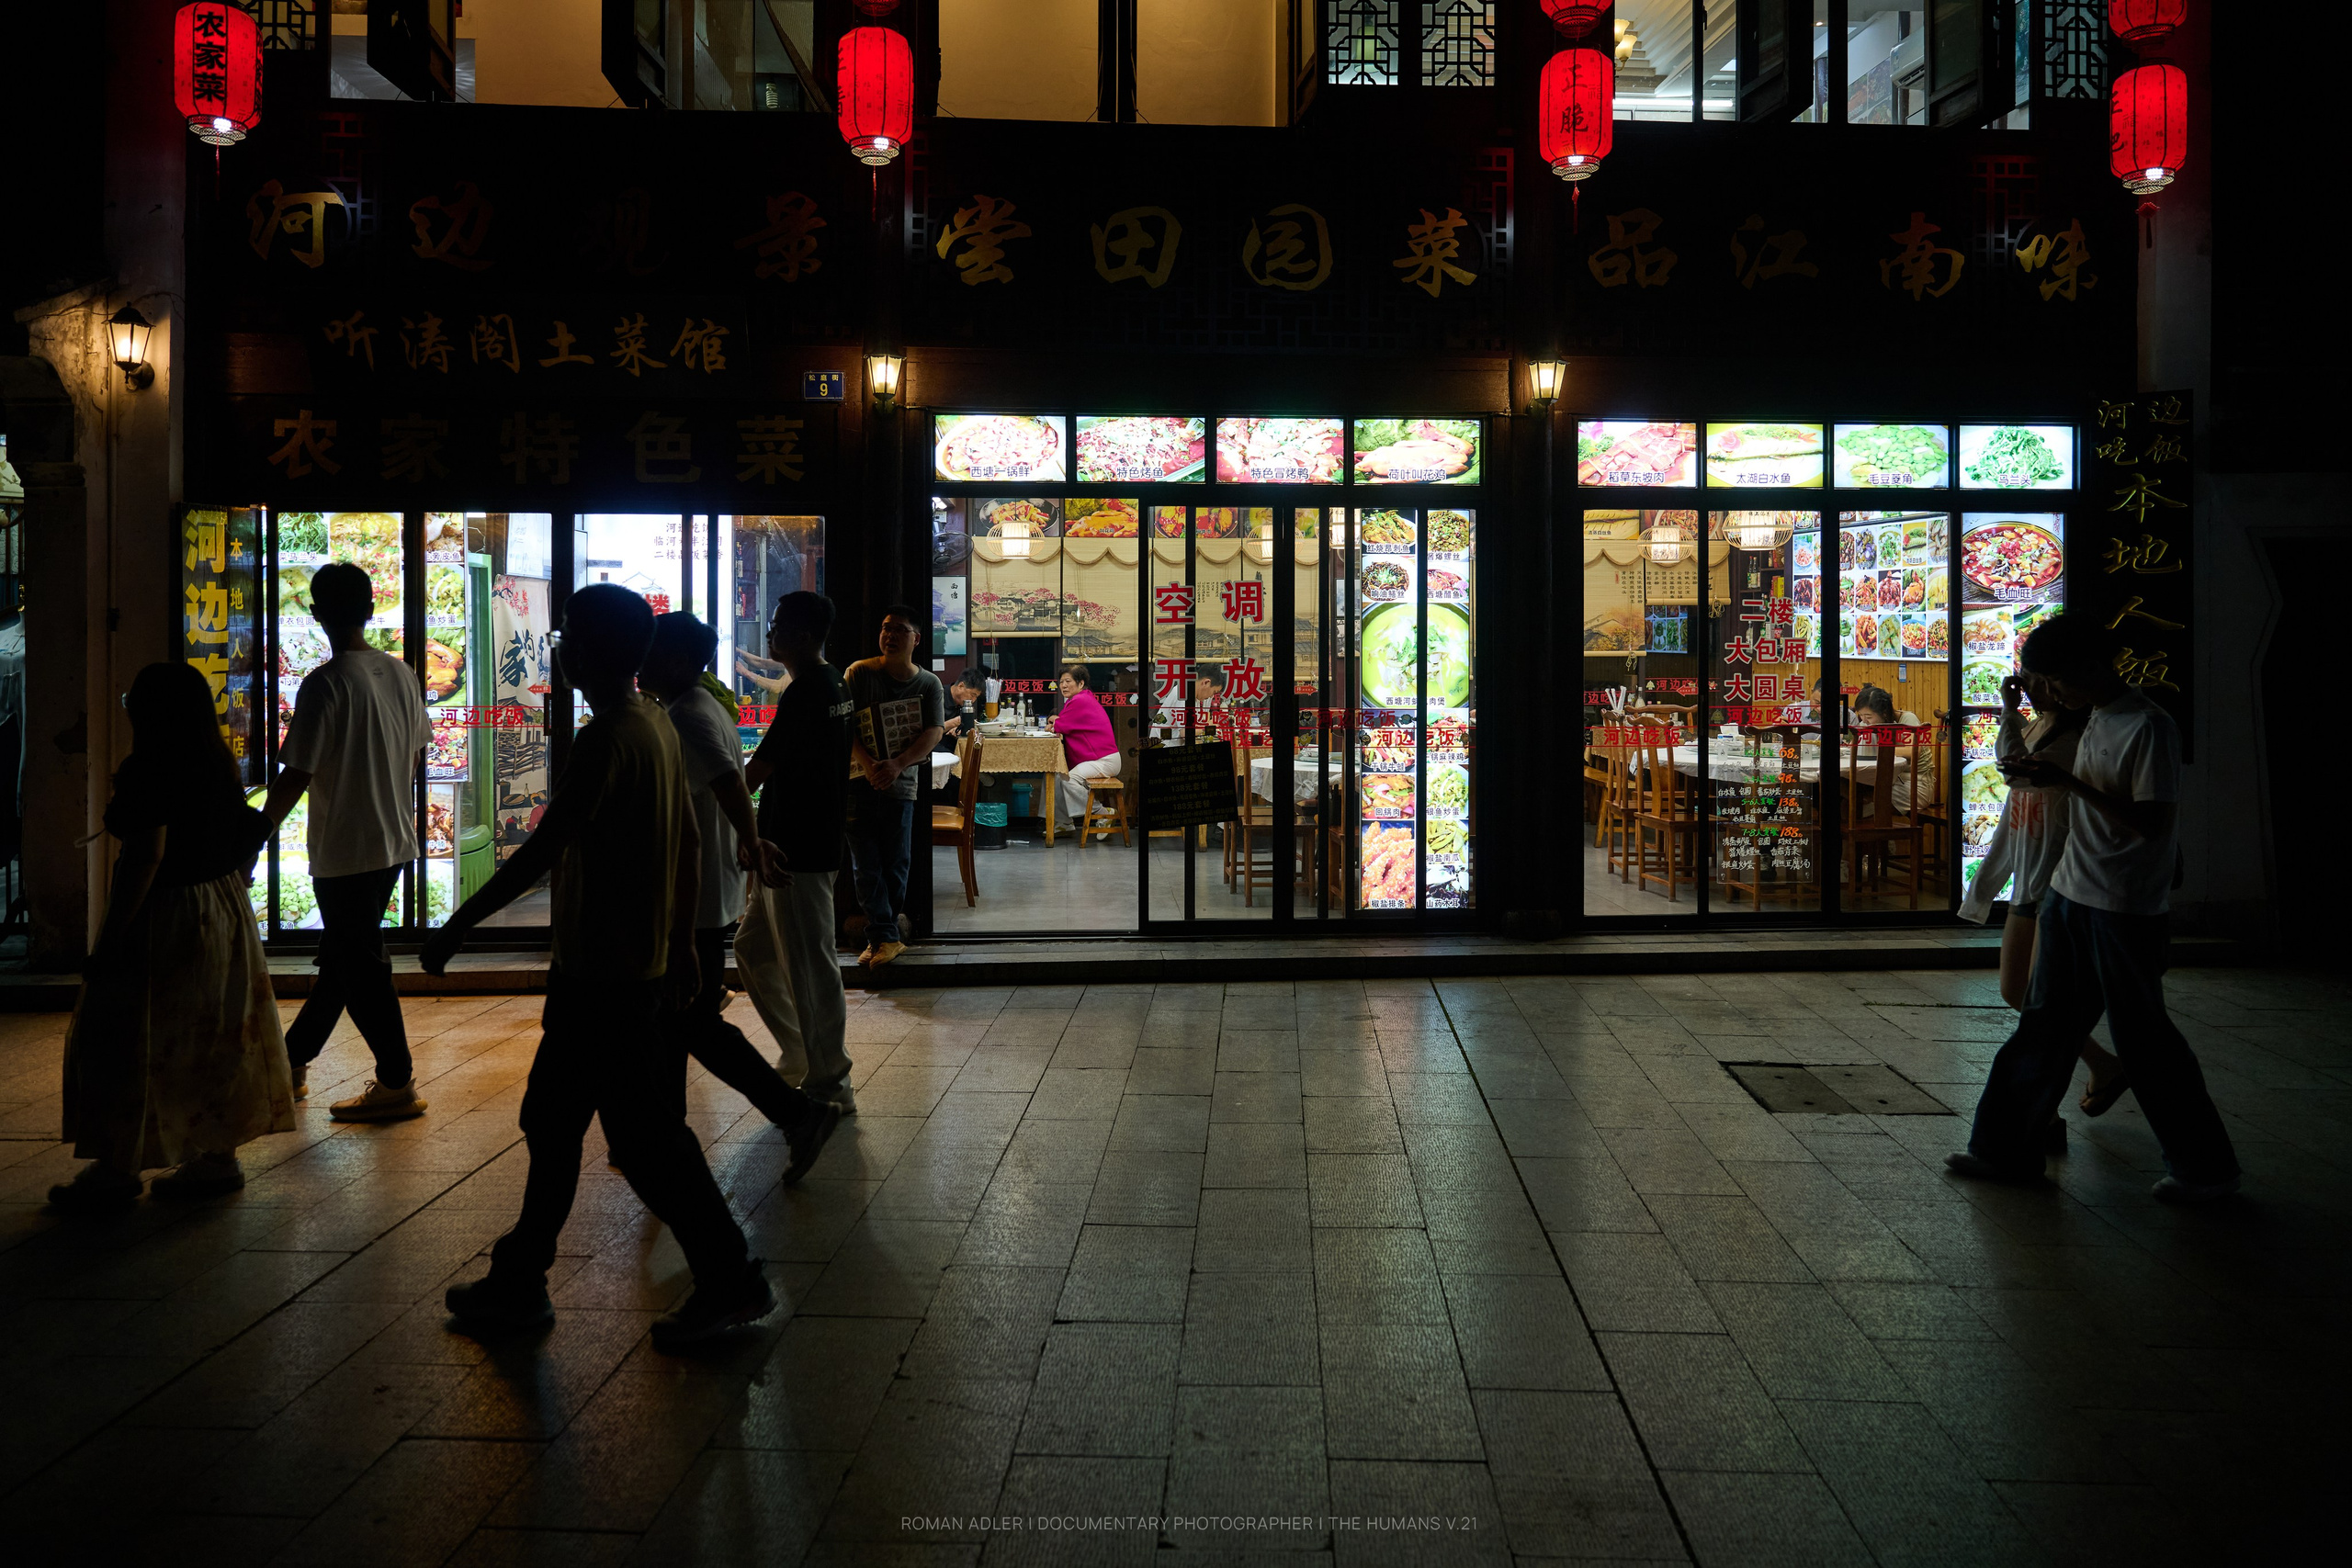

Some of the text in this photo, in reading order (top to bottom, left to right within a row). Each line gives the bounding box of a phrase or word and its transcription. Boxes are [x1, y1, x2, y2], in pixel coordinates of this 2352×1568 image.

[195, 11, 226, 102] 农家菜
[246, 179, 827, 283] 河边观景
[936, 194, 1477, 298] 尝田园菜
[1587, 207, 2098, 301] 品江南味
[322, 310, 731, 376] 听涛阁土菜馆
[820, 383, 829, 397] 9
[268, 410, 806, 485] 农家特色菜
[970, 466, 1031, 479] 西塘一锅鲜
[1116, 467, 1164, 479] 特色烤鱼
[1250, 467, 1309, 479] 特色冒烤鸭
[1388, 468, 1447, 481] 荷叶叫花鸡
[1608, 471, 1665, 484] 稻草东坡肉
[1736, 472, 1791, 484] 太湖白水鱼
[1869, 472, 1913, 485] 毛豆菱角
[1998, 473, 2031, 486] 马兰头
[1994, 588, 2032, 599] 毛血旺
[1155, 580, 1264, 625] 空调
[1740, 597, 1794, 626] 二楼
[186, 509, 231, 746] 河边吃
[230, 538, 244, 758] 本地人饭店
[1724, 637, 1806, 664] 大包厢
[1154, 658, 1267, 702] 开放
[1724, 674, 1806, 702] 大圆桌
[1385, 696, 1445, 705] 西塘河蚌肉煲
[1973, 694, 2001, 704] 酸菜鱼
[440, 707, 525, 727] 河边吃饭
[1170, 709, 1251, 727] 河边吃饭
[1317, 710, 1396, 727] 河边吃饭
[1727, 707, 1803, 725] 河边吃饭
[1216, 730, 1273, 746] 河边吃
[1604, 728, 1680, 745] 河边吃饭
[1857, 728, 1932, 746] 河边吃饭
[1372, 761, 1406, 772] 干锅牛蛙
[1374, 807, 1401, 817] 回锅肉
[1426, 807, 1460, 816] 银鱼炒蛋
[1371, 899, 1406, 908] 椒盐排条
[1426, 898, 1460, 908] 山药木耳
